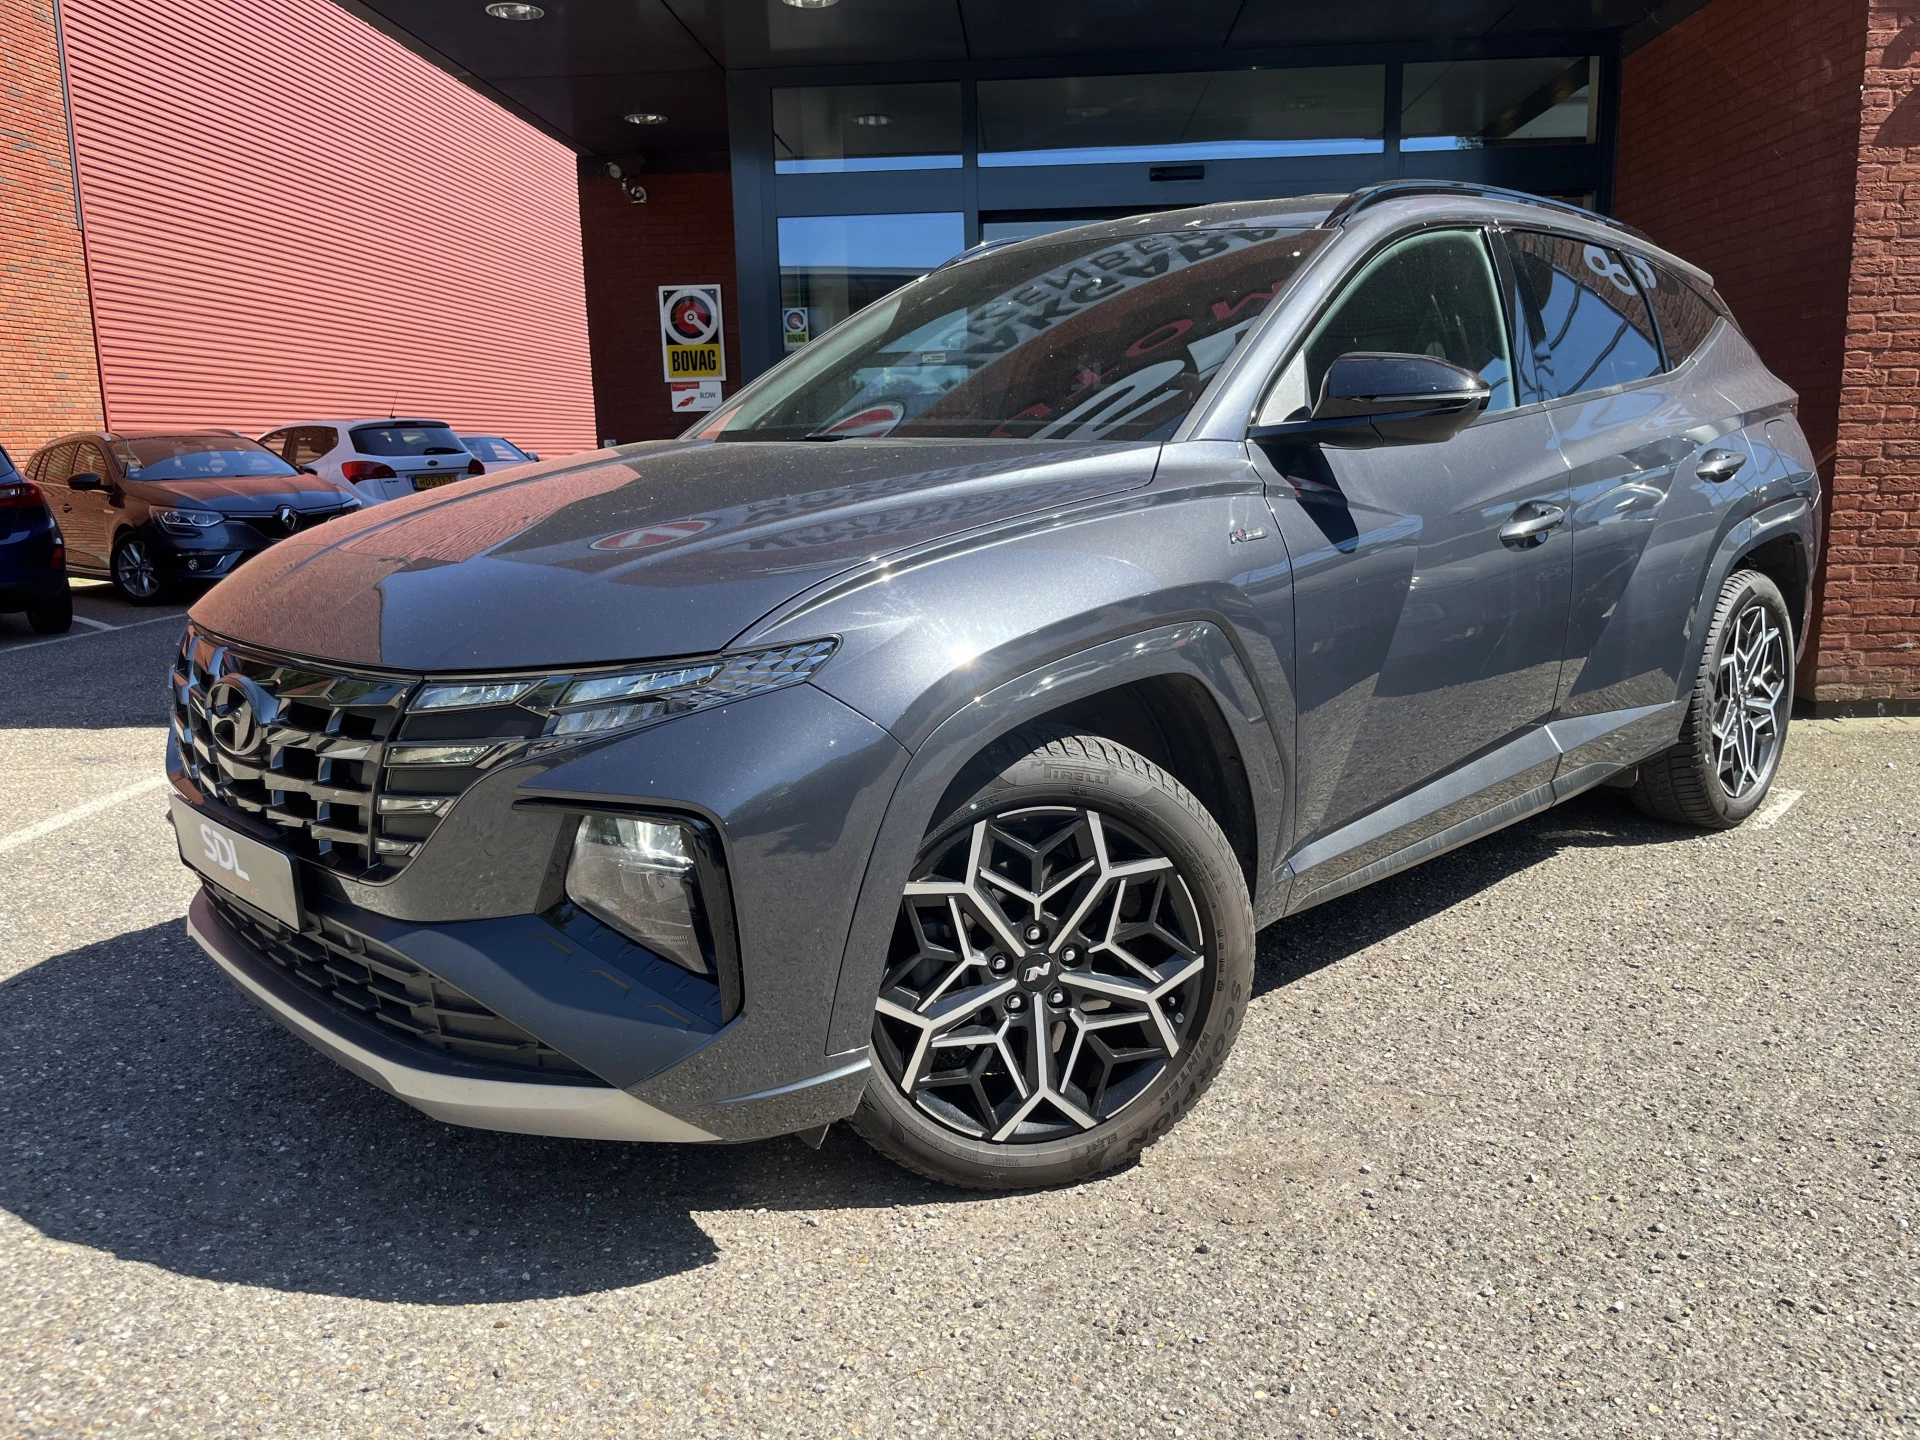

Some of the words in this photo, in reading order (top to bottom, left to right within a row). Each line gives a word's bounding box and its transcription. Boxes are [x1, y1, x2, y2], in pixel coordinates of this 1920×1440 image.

[787, 333, 806, 343] BOVAG
[672, 350, 717, 372] BOVAG
[1043, 763, 1111, 786] PIRELLI
[200, 823, 250, 881] SDL
[1127, 982, 1241, 1152] SCORPION
[1159, 1031, 1212, 1106] WINTER
